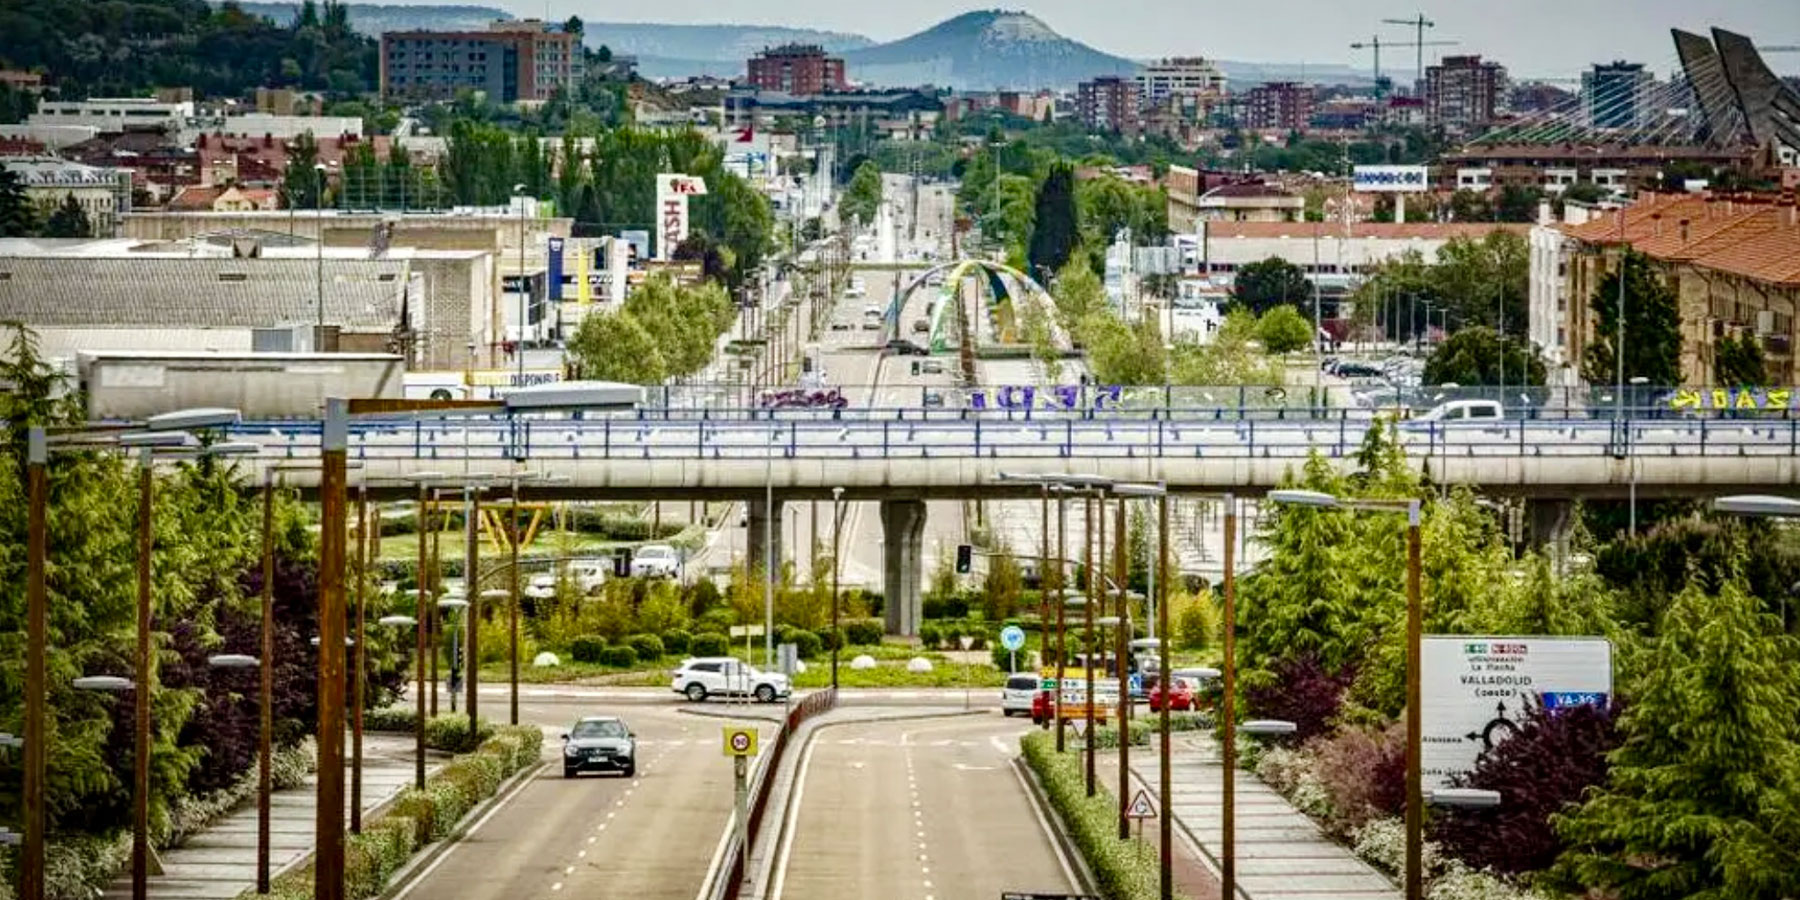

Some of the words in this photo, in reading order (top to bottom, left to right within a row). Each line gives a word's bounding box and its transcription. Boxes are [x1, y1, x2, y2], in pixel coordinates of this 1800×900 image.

[664, 200, 681, 257] ASH
[1460, 676, 1532, 685] VALLADOLID
[1475, 687, 1517, 697] (oeste)
